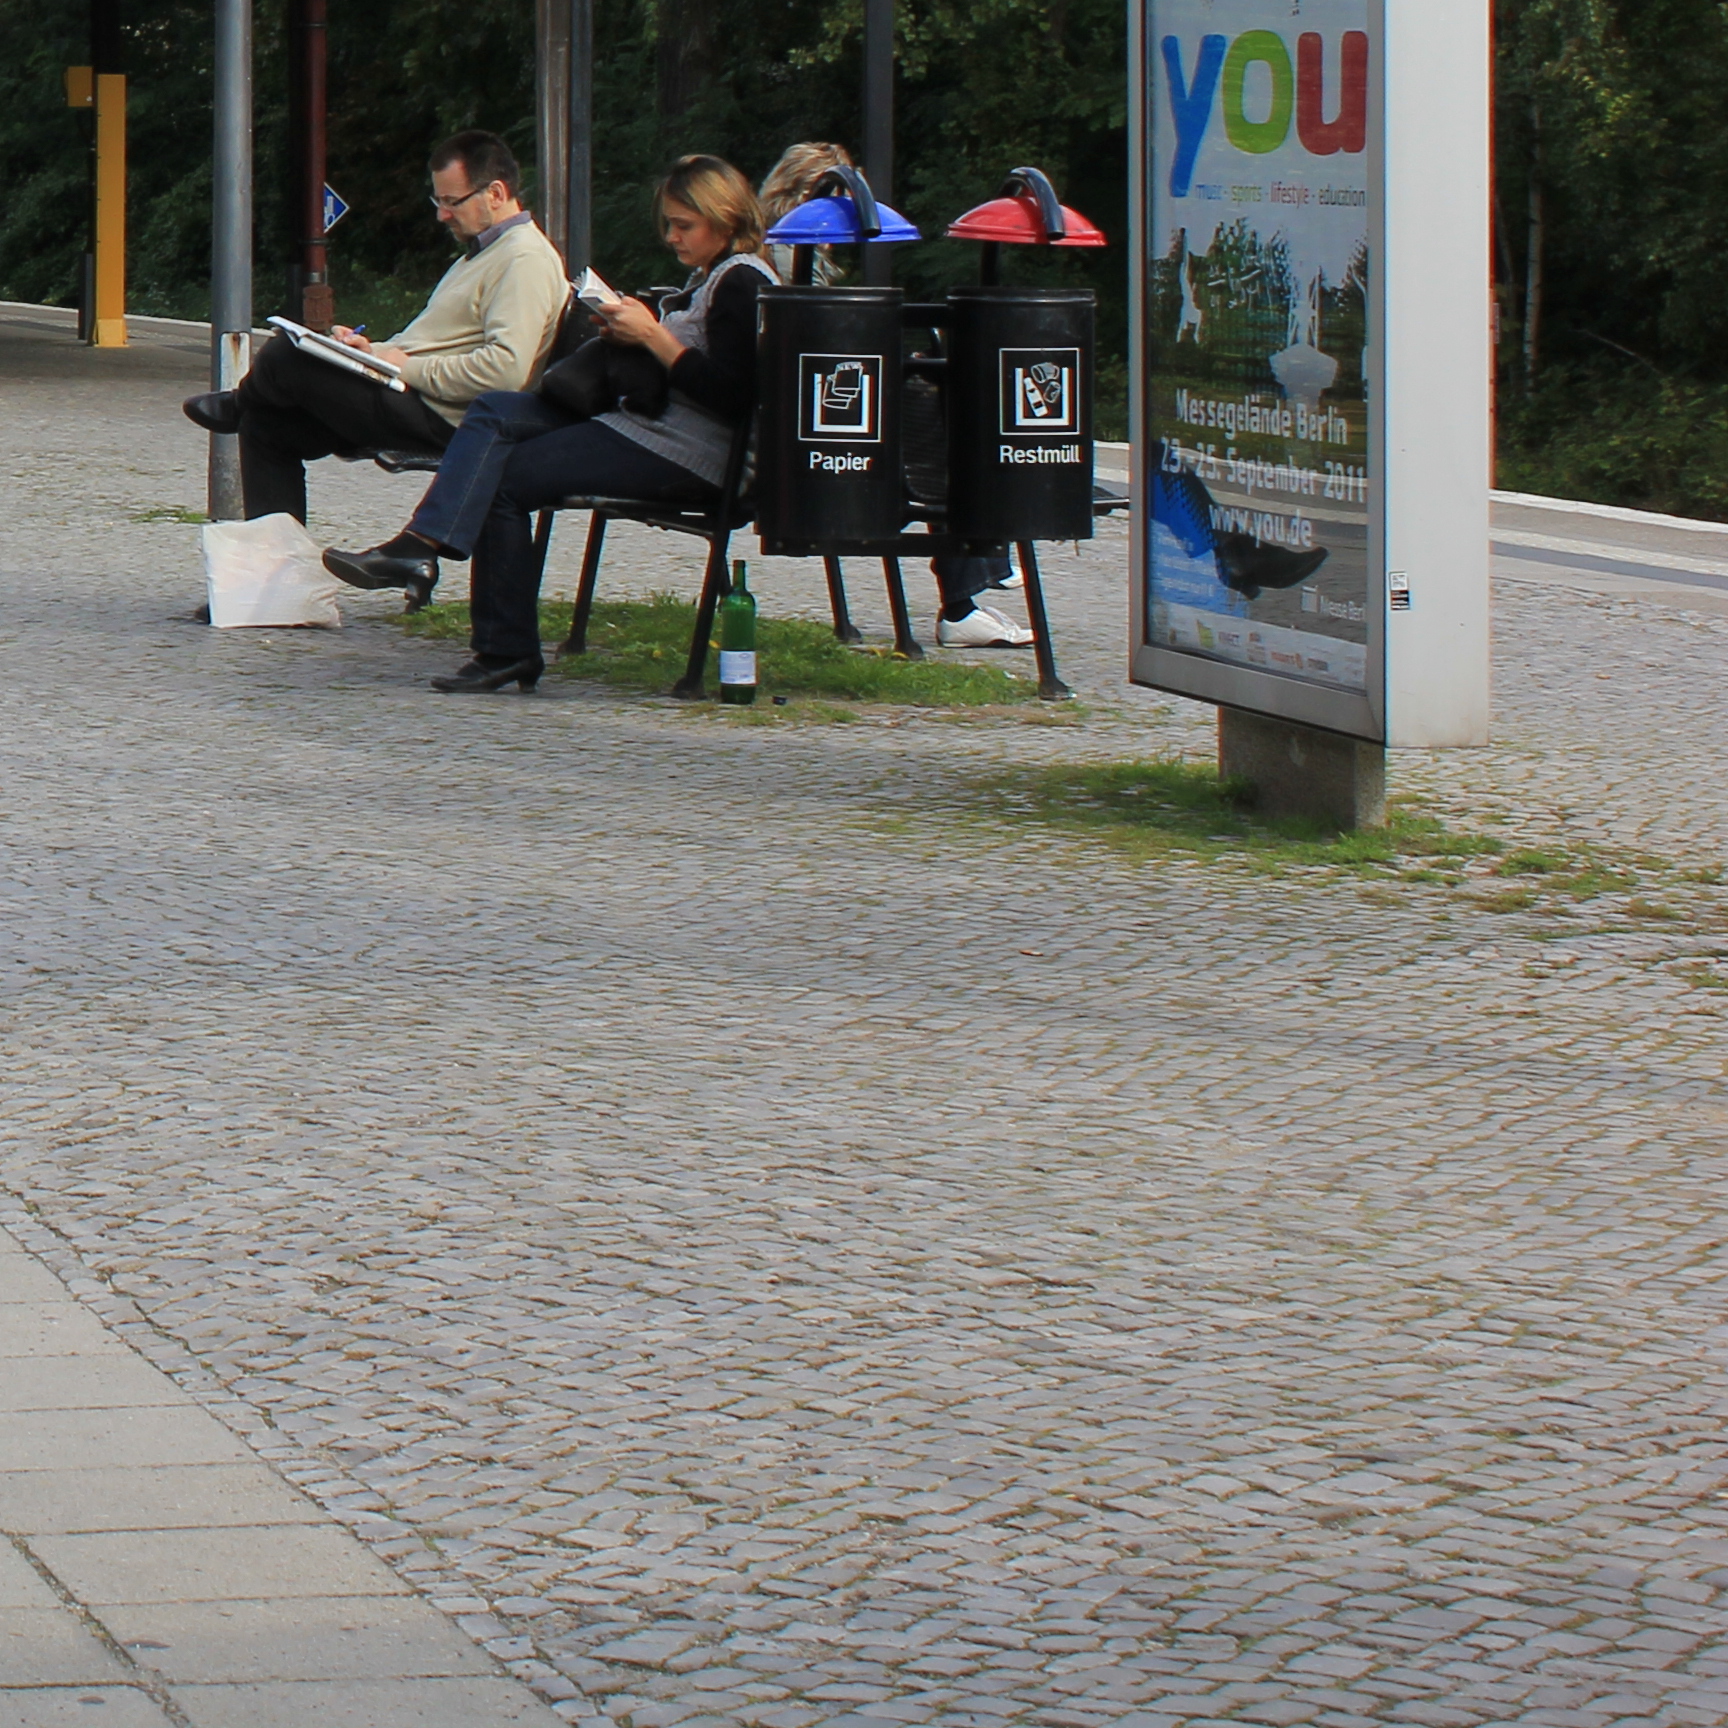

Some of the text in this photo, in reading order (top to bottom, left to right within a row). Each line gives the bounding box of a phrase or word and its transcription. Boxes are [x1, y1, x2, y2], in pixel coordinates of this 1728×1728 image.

[1161, 29, 1368, 198] you
[1270, 181, 1310, 209] lifestyle
[1318, 183, 1366, 206] education
[1175, 387, 1348, 445] Messegelände Berlin
[809, 451, 871, 474] Papier
[1000, 444, 1081, 464] Restmüll
[1227, 446, 1318, 496] September
[1323, 459, 1366, 503] 2011
[1208, 503, 1314, 549] www.you.de
